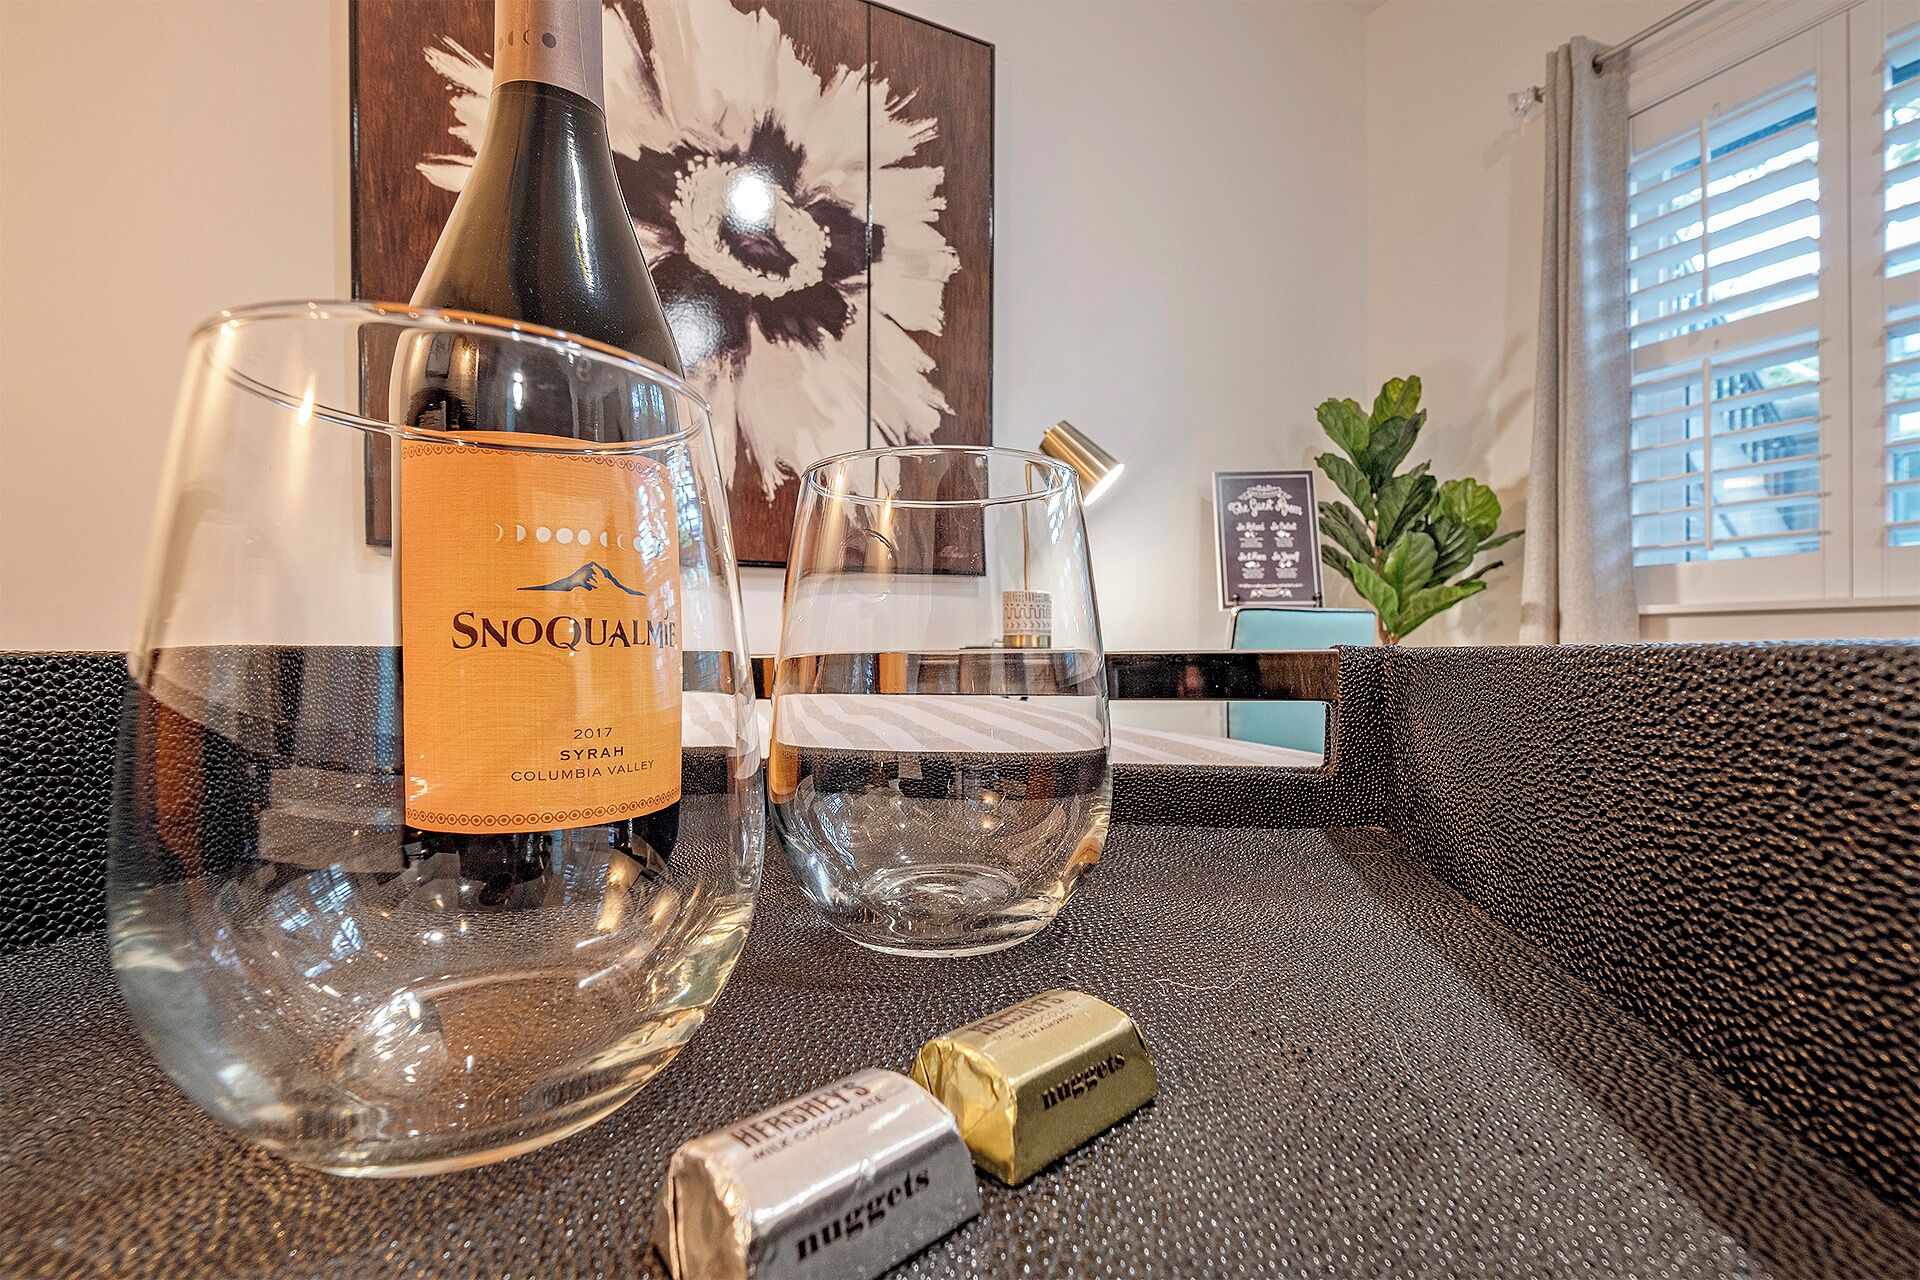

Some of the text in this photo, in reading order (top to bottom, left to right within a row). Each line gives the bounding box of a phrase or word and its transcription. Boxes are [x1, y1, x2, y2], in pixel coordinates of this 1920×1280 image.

[452, 609, 676, 651] SNOQUALMIE
[573, 727, 612, 740] 2017
[560, 746, 624, 761] SYRAH
[511, 759, 655, 782] COLUMBIA VALLEY
[1042, 1052, 1126, 1110] nuggets
[797, 1169, 930, 1262] nuggets
